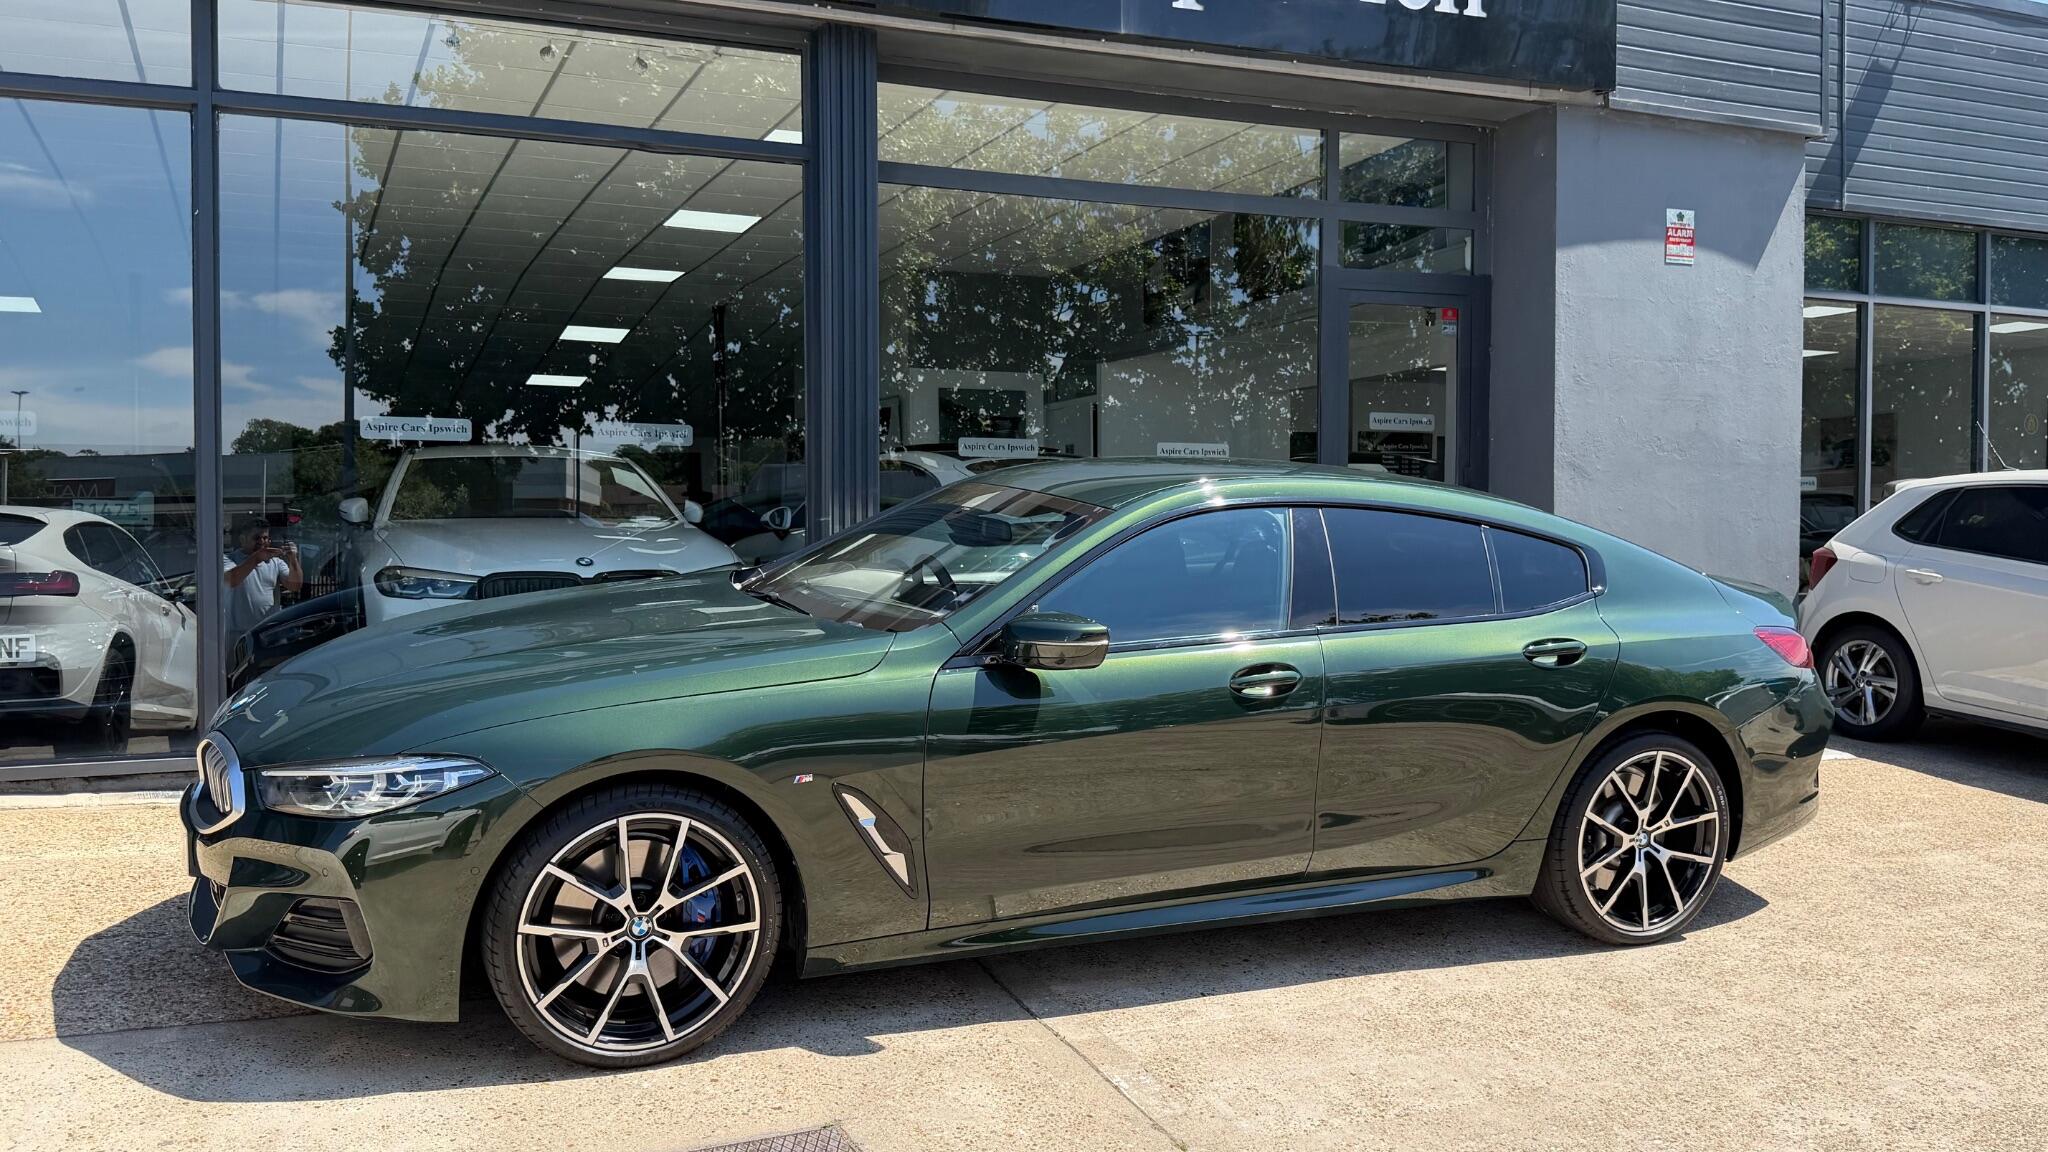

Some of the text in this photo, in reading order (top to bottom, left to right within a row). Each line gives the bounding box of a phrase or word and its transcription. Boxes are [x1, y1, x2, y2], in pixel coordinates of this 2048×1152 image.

[1667, 228, 1693, 238] ALARM
[1373, 416, 1392, 425] Aspire
[365, 422, 468, 435] Aspire Cars Ipswich
[599, 428, 628, 438] Aspire
[630, 428, 652, 438] Cars
[962, 443, 1035, 453] Aspire Cars Ipswich
[1160, 447, 1227, 457] Aspire Cars Ipswich
